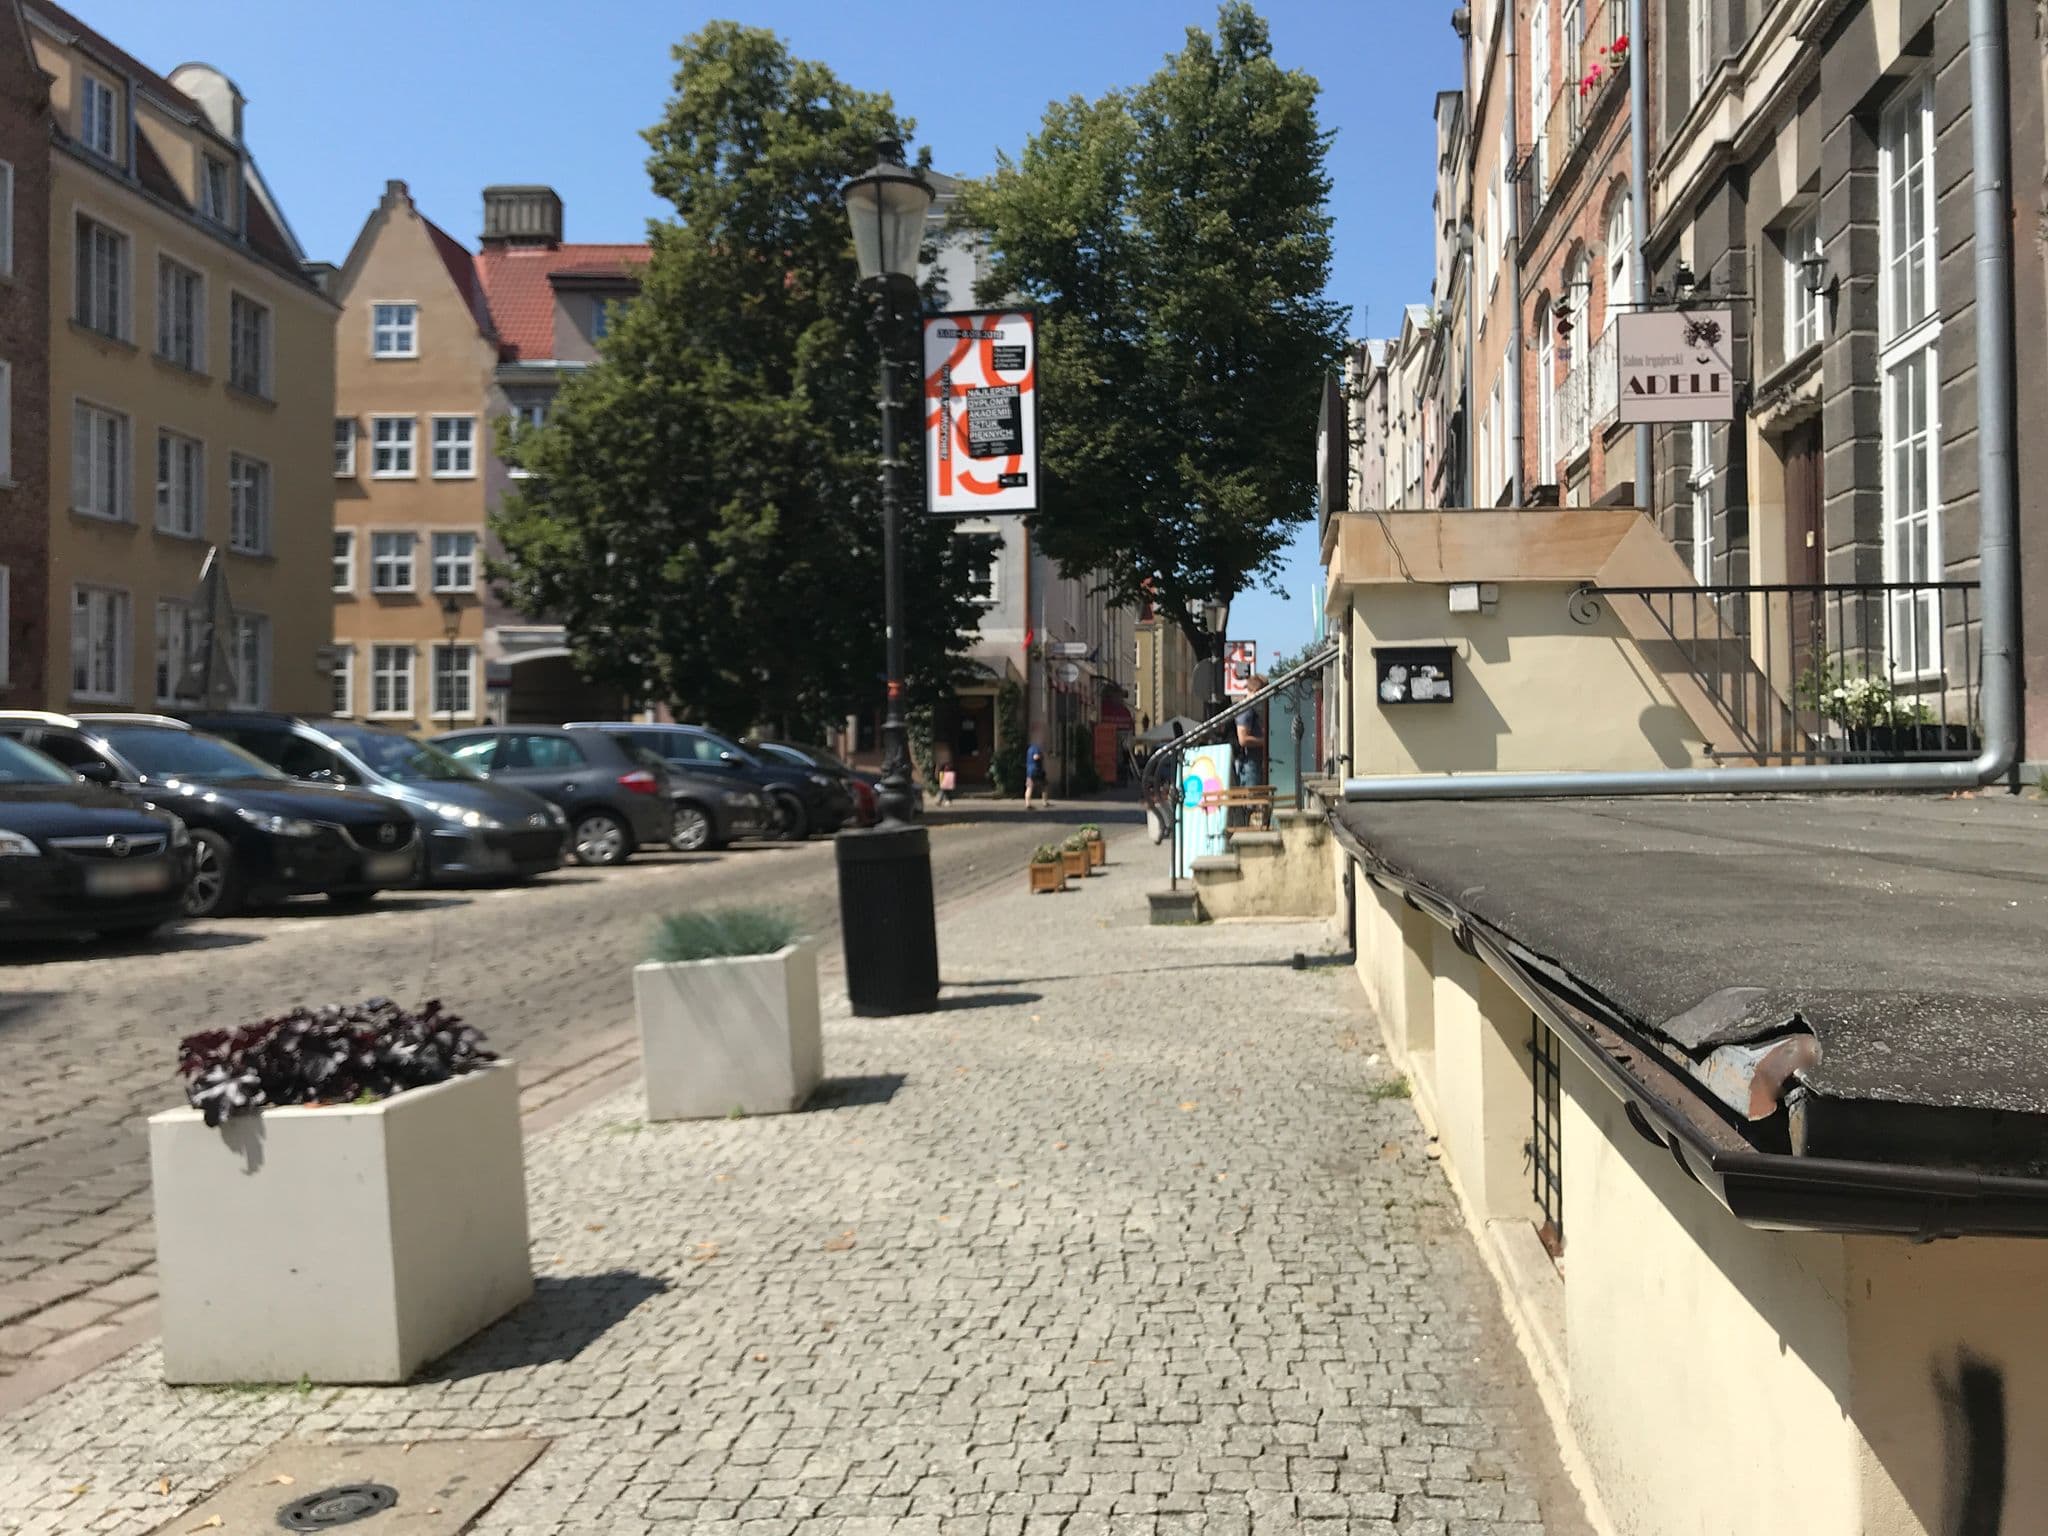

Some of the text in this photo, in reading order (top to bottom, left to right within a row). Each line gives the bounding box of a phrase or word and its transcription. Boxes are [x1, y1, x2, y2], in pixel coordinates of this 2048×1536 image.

[1622, 372, 1729, 395] ADELE
[967, 385, 1017, 397] NAJLEPSZE
[967, 397, 1010, 408] DYPLOMY
[968, 408, 1012, 418] AKADEMII
[969, 419, 998, 429] SZTUK
